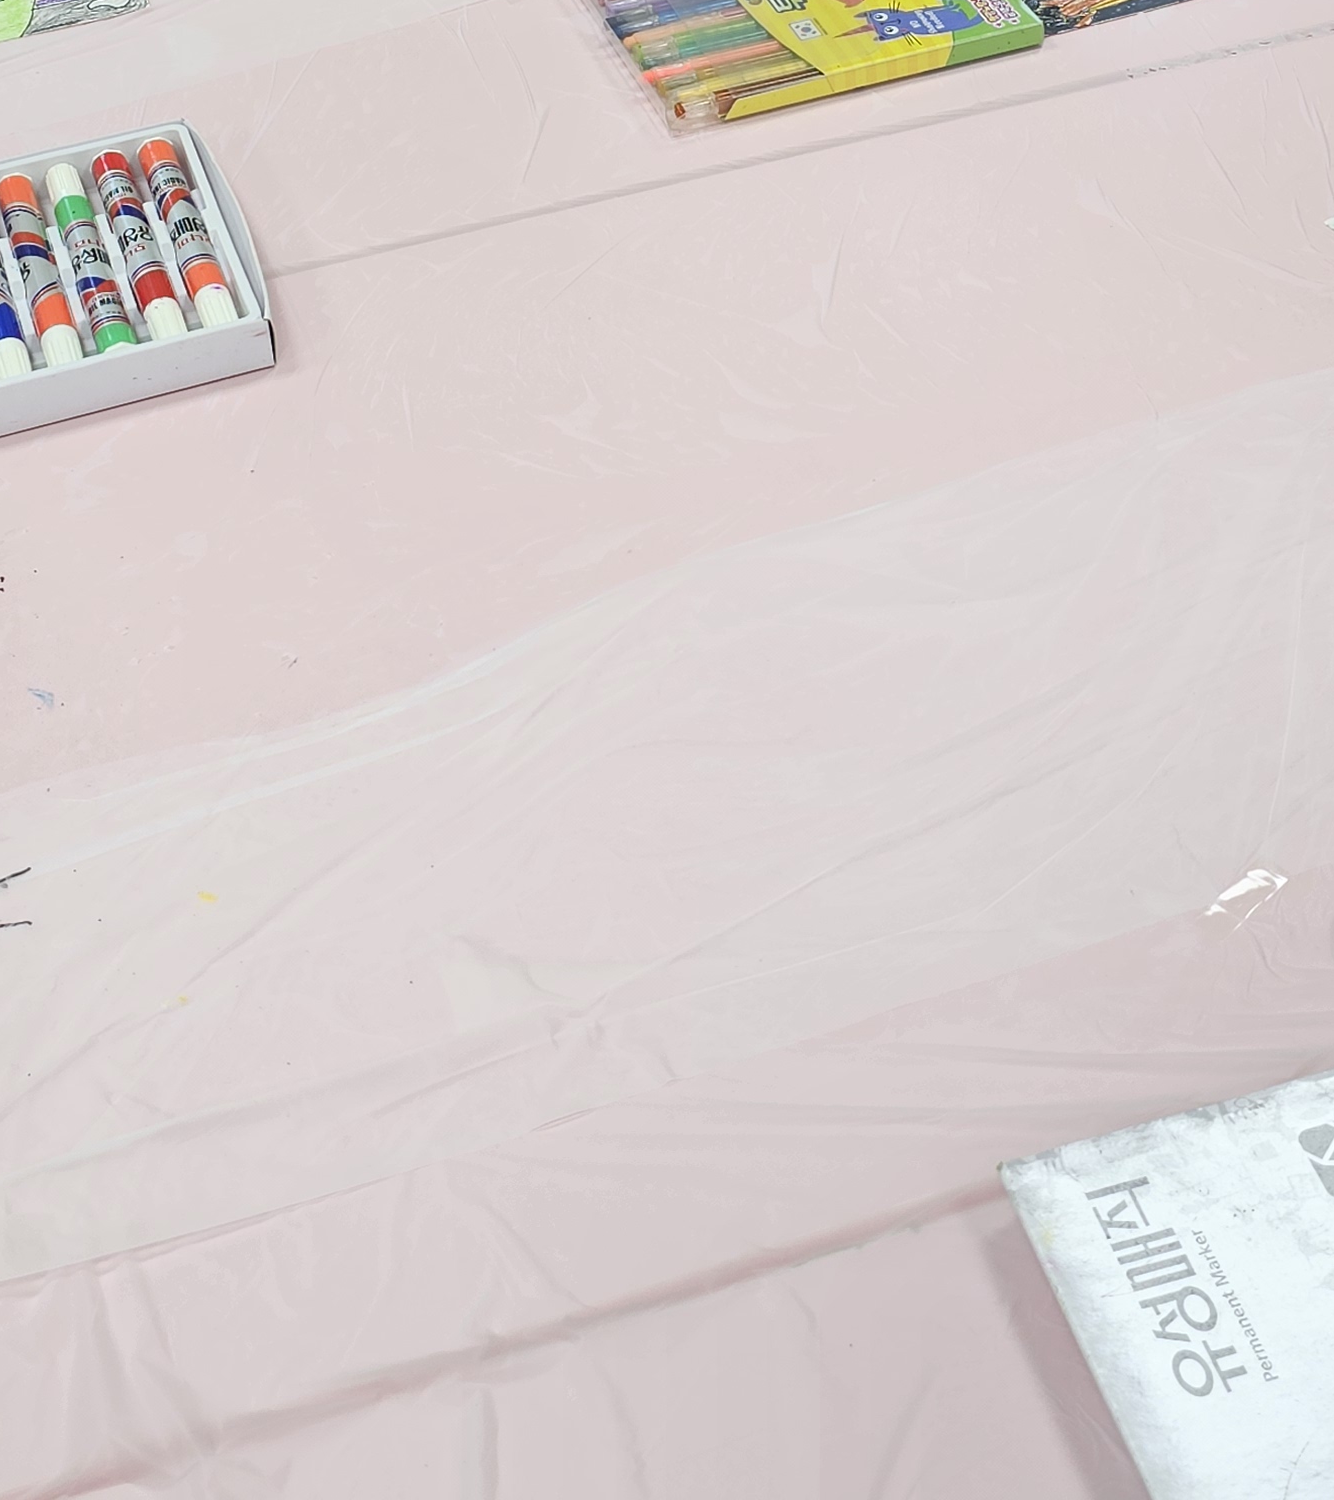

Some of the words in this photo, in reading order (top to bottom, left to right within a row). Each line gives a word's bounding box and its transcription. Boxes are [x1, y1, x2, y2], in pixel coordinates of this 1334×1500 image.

[1084, 1175, 1249, 1398] 유성매직
[1191, 1227, 1230, 1288] Marker
[1222, 1288, 1280, 1383] Permanent
